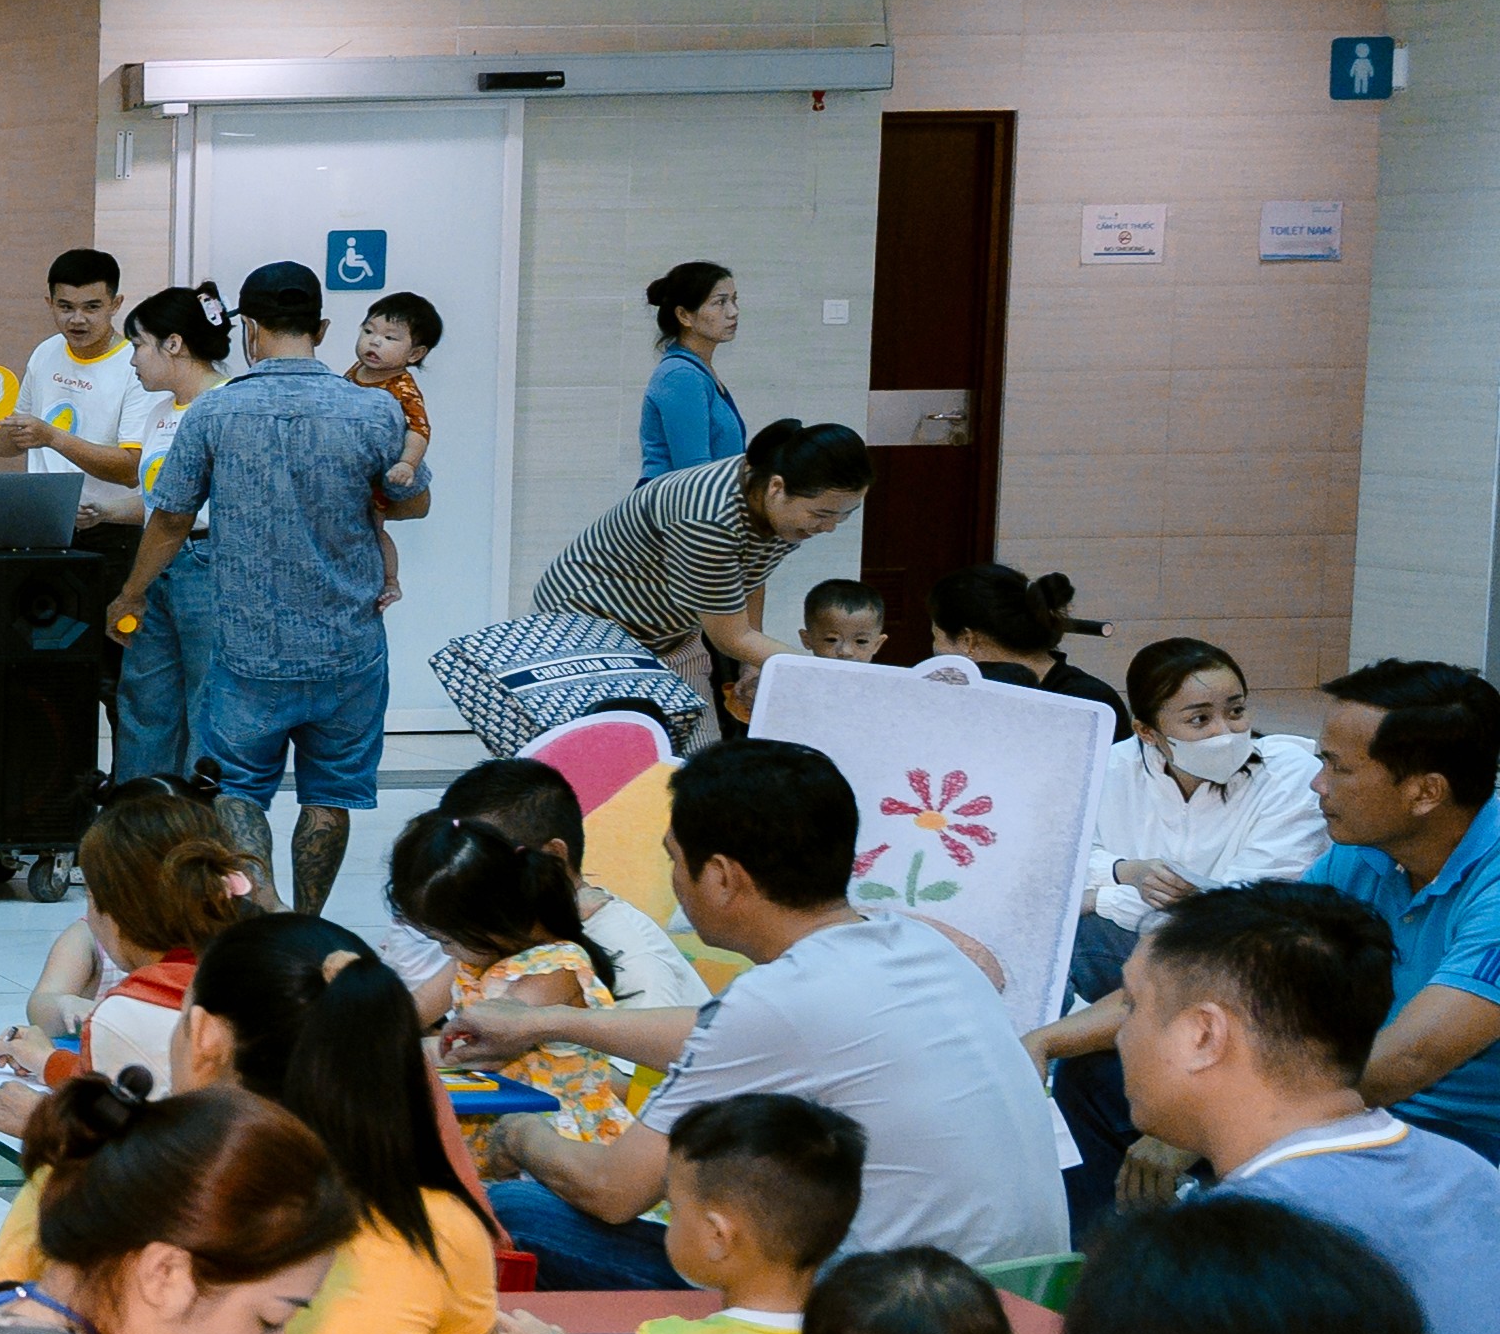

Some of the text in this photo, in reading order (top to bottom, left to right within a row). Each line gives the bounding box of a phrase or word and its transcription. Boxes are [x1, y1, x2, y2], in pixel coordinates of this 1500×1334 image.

[1269, 226, 1333, 236] TOILET NAM
[530, 657, 640, 681] CHRISTIAN DIOR
